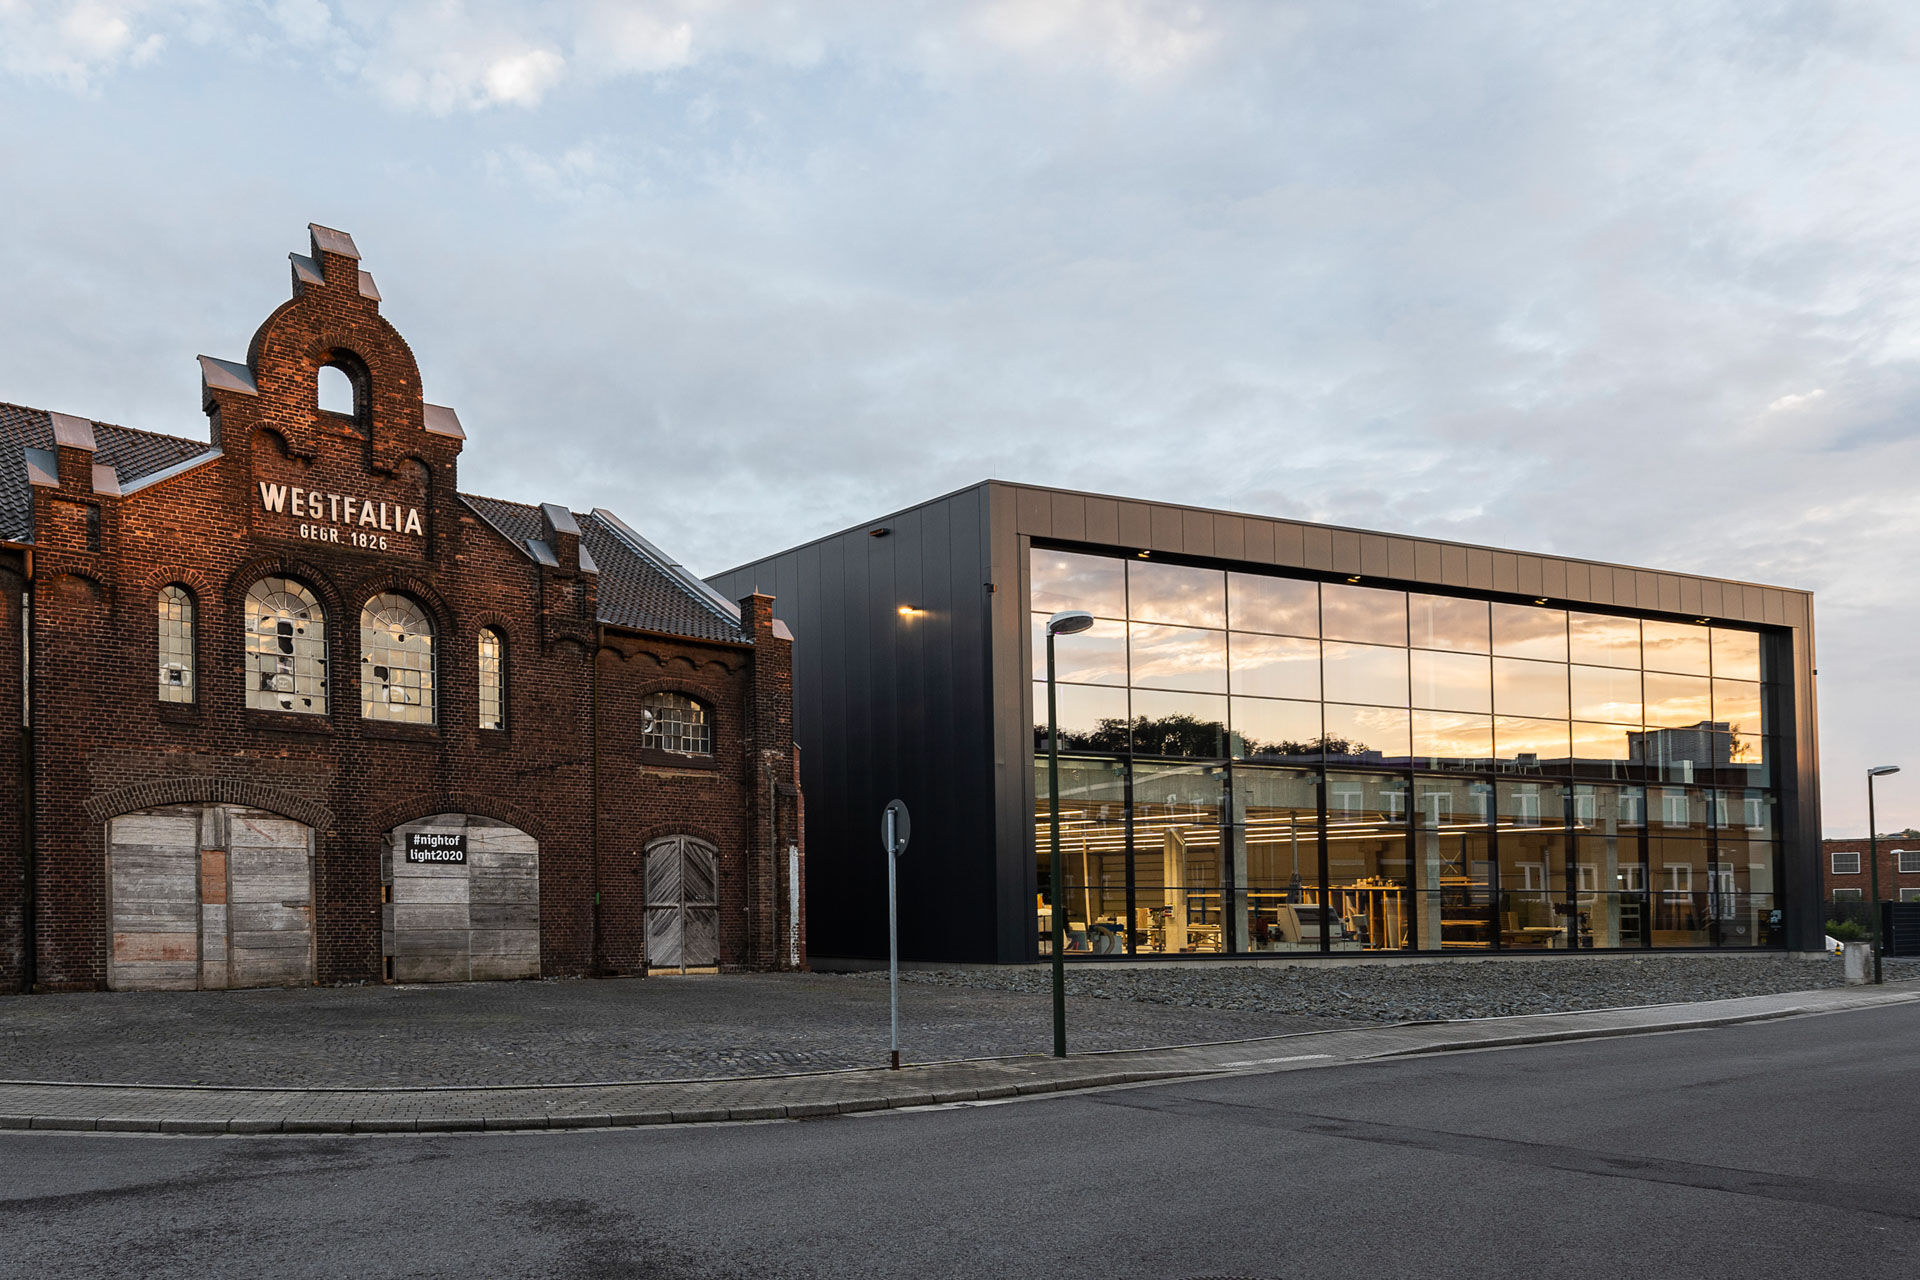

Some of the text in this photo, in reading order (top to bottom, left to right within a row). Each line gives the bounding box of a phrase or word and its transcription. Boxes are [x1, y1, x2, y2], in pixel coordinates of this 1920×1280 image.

[259, 481, 423, 536] WESTFALIA
[300, 523, 388, 551] GEGR. 1826
[413, 834, 460, 848] #nightof
[410, 849, 463, 863] light2020
